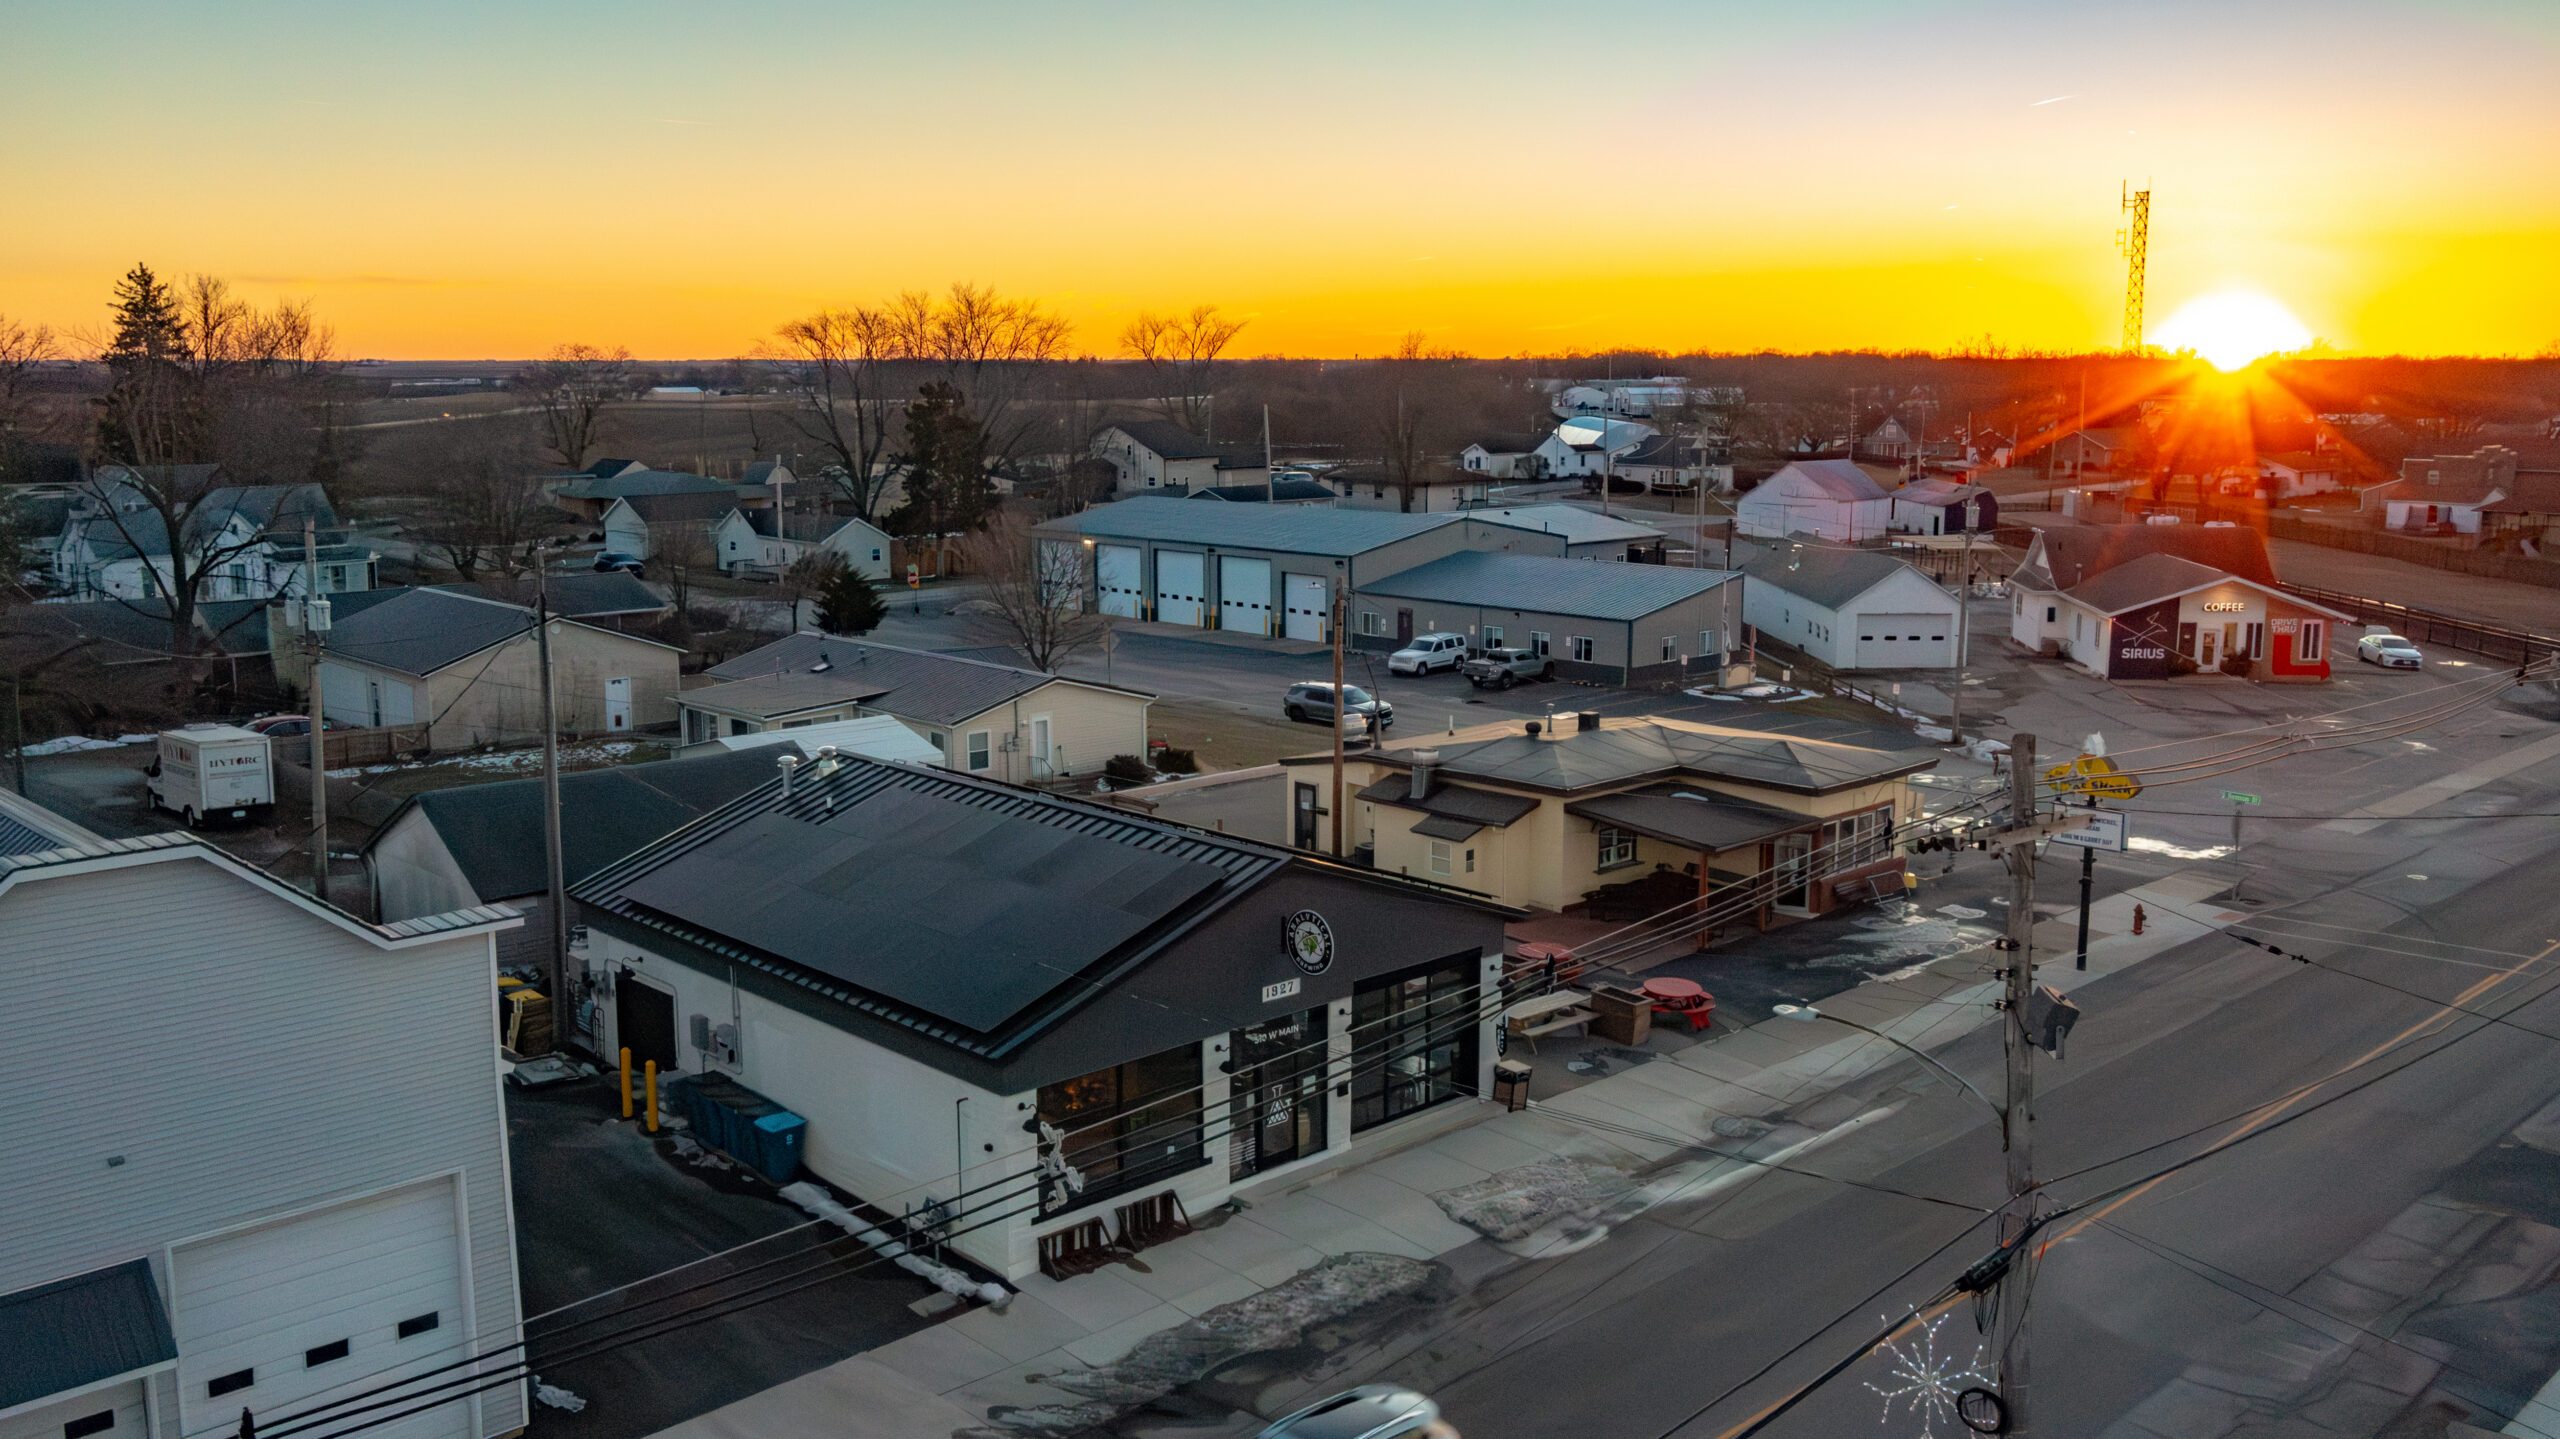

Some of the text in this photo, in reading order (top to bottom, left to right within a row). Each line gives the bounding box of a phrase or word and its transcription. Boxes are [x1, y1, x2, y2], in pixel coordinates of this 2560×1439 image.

[2203, 602, 2244, 612] COFFEE
[2271, 618, 2298, 626] DRIVE
[2271, 625, 2297, 633] THRU
[2121, 648, 2165, 659] SIRIUS
[1289, 912, 1331, 949] ANALYTICAL
[1296, 956, 1324, 971] BREWING
[1266, 981, 1294, 999] 1927
[1268, 1030, 1278, 1040] W
[1278, 1024, 1300, 1037] MAIN
